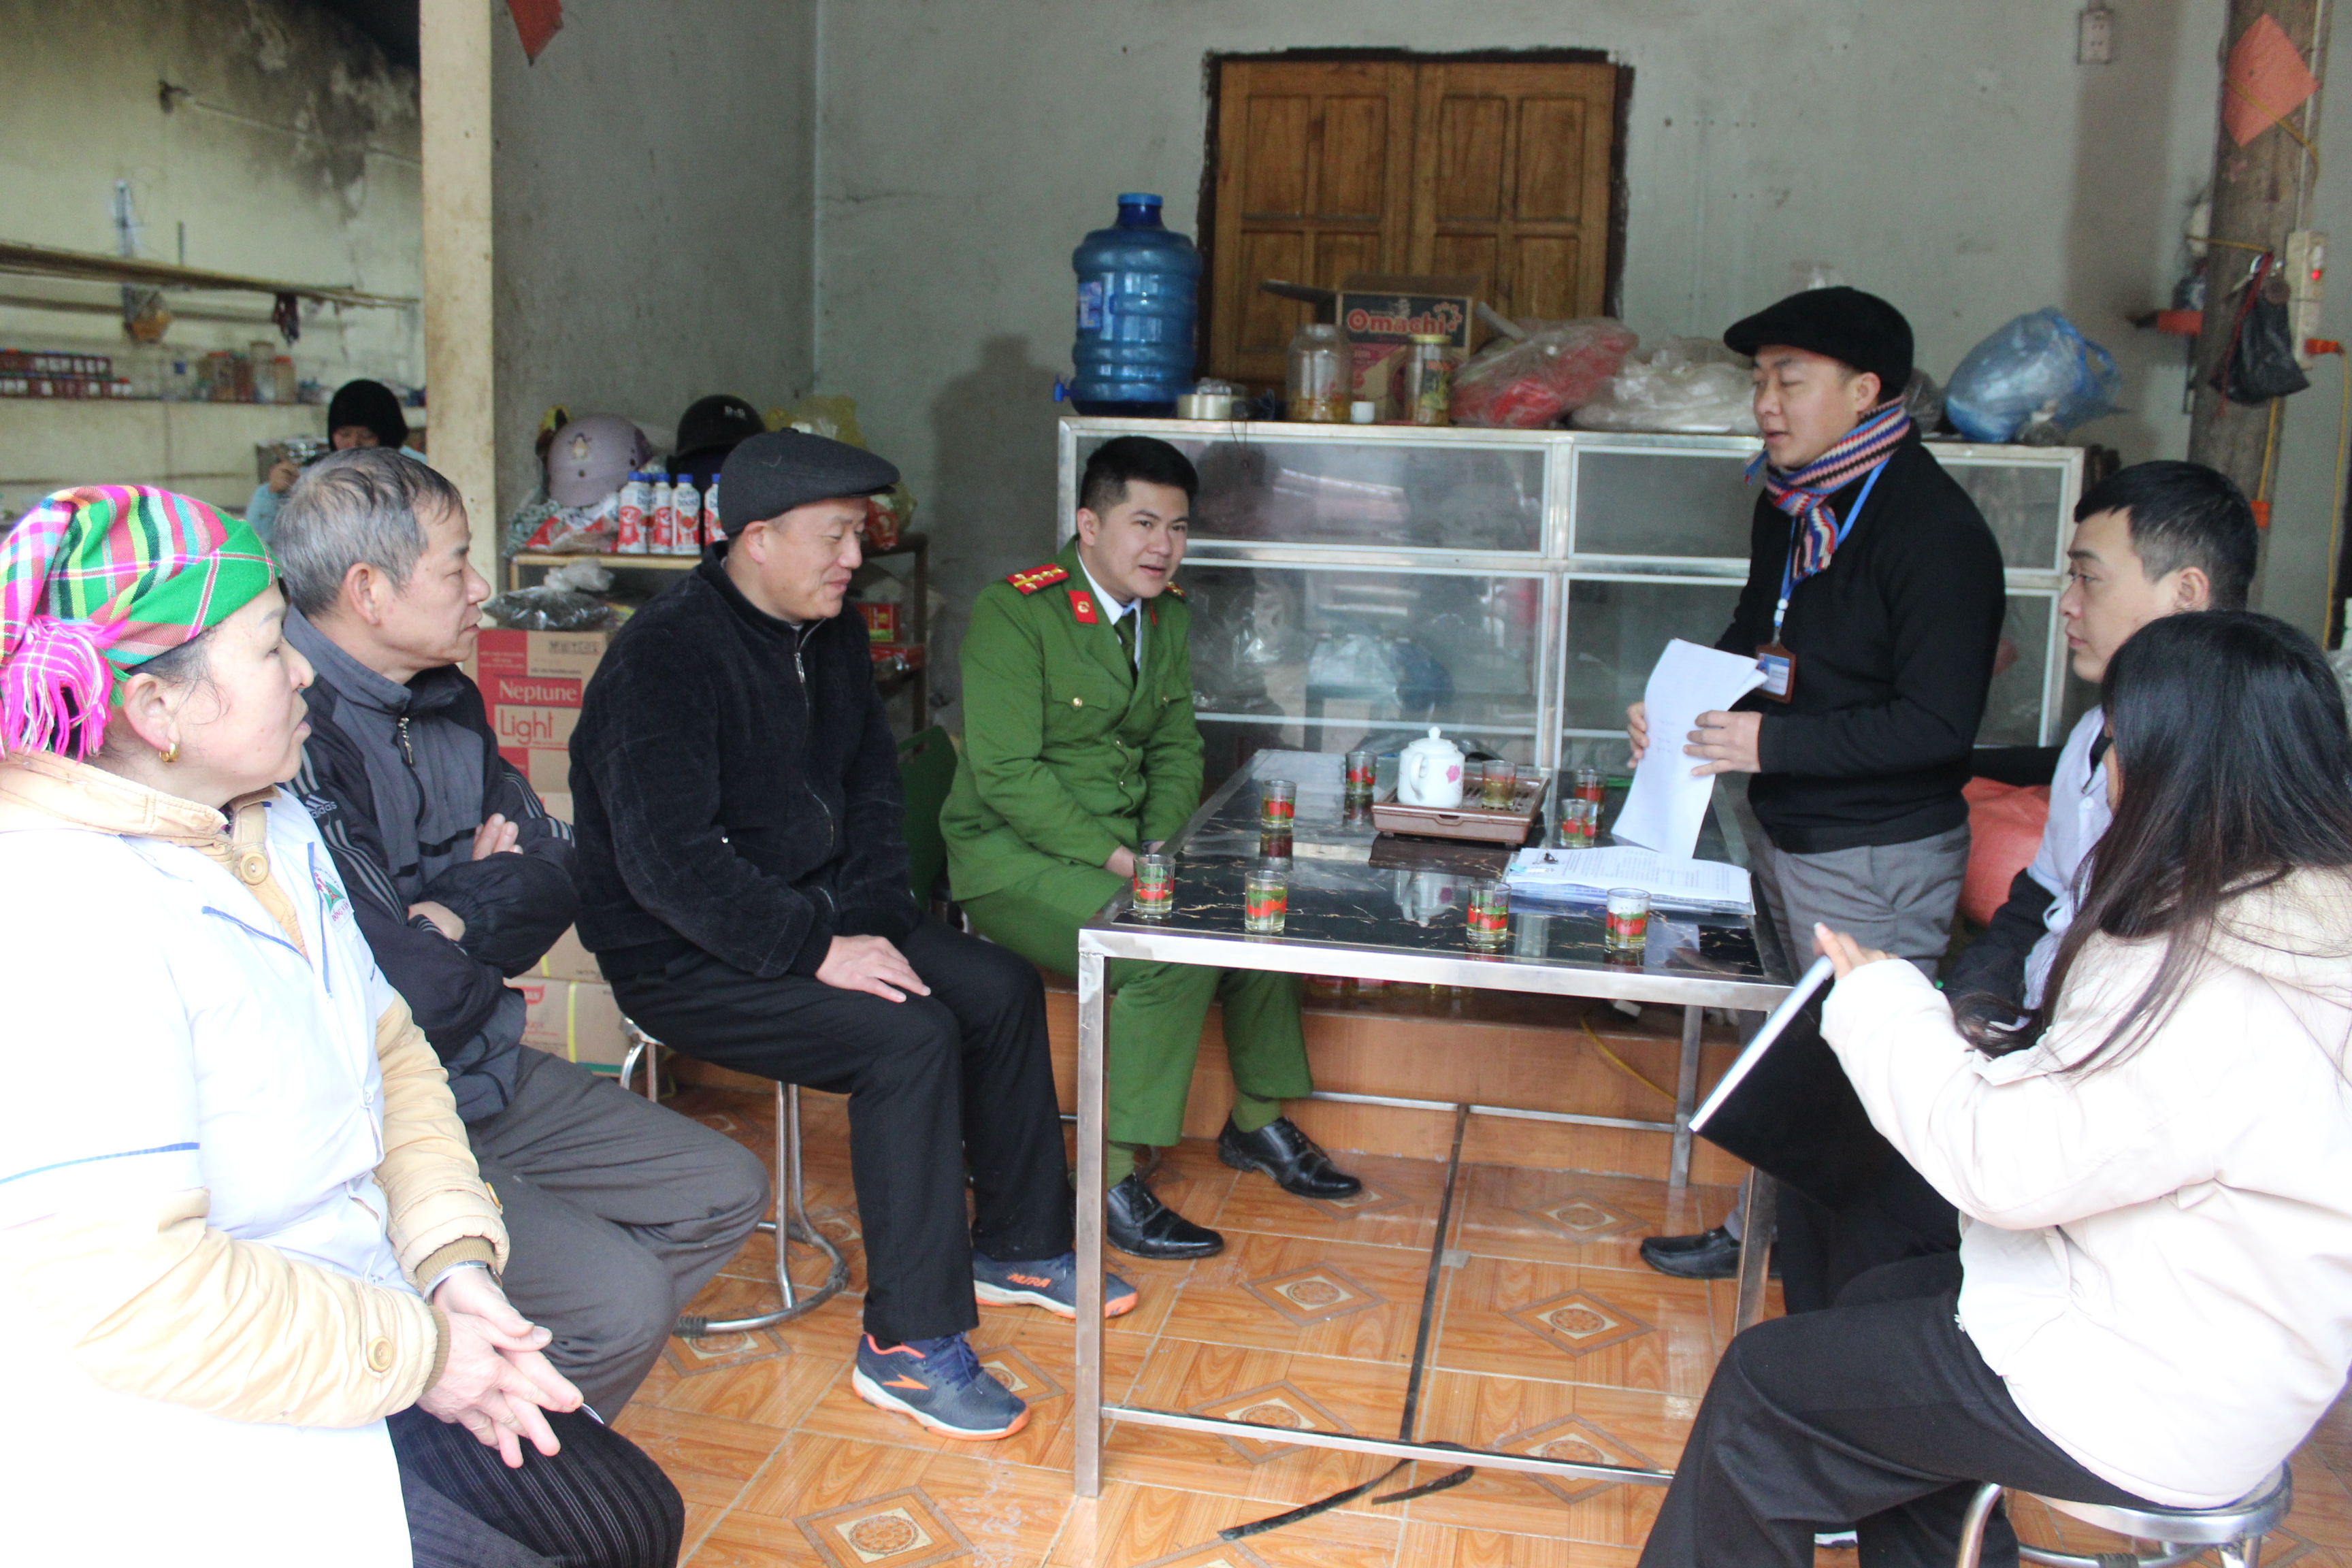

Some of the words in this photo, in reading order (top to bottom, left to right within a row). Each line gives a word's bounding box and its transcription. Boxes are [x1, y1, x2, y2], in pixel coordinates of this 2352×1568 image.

[1348, 308, 1446, 335] Omachi
[498, 679, 578, 704] Neptune
[500, 708, 553, 745] Light
[311, 801, 338, 819] didas
